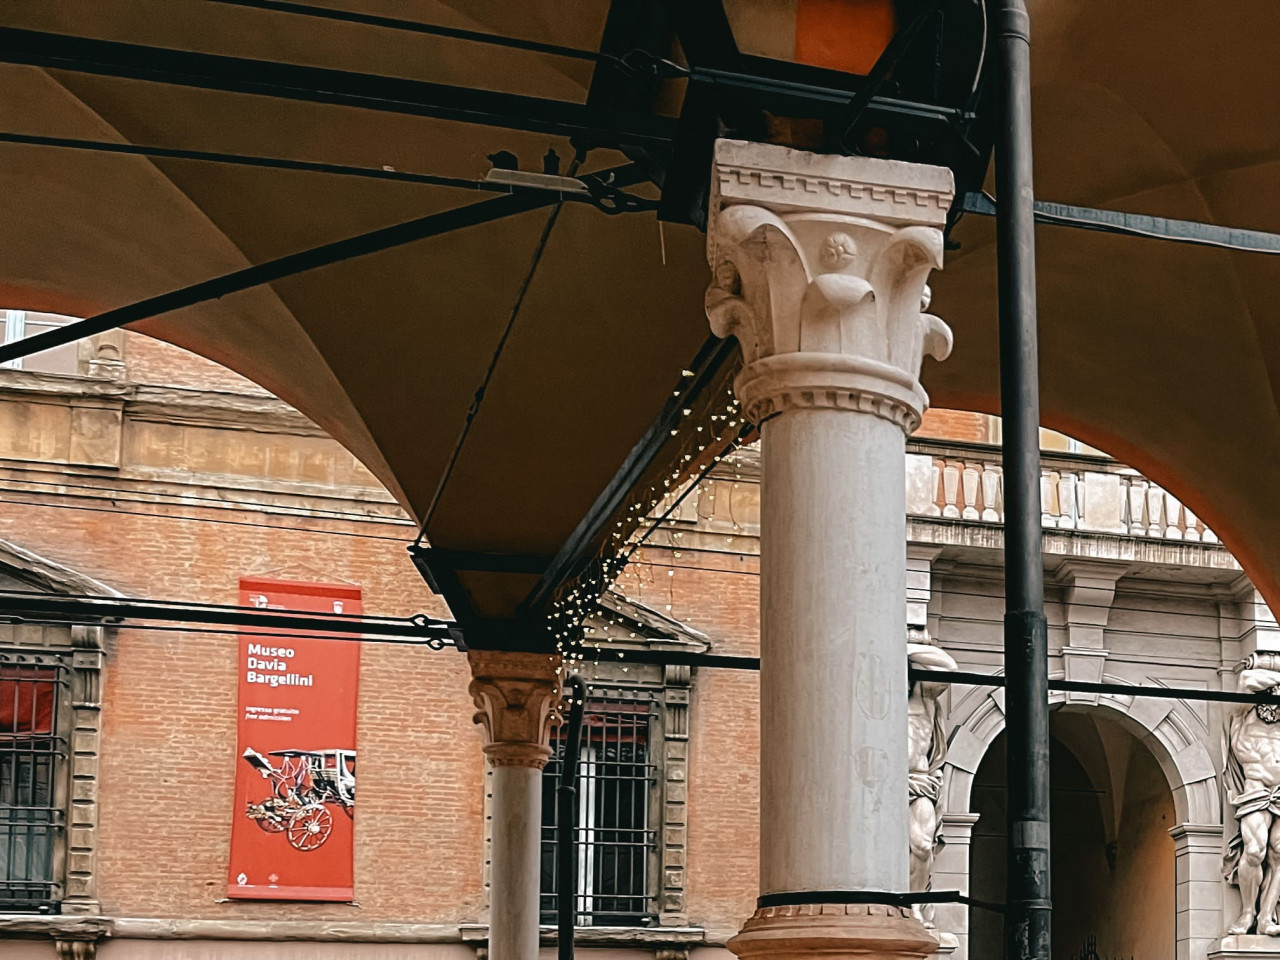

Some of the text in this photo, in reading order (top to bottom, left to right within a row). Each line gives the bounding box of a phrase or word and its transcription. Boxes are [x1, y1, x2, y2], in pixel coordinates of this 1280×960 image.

[248, 643, 295, 658] Museo
[247, 657, 287, 671] Davia
[247, 671, 313, 688] Bargellini
